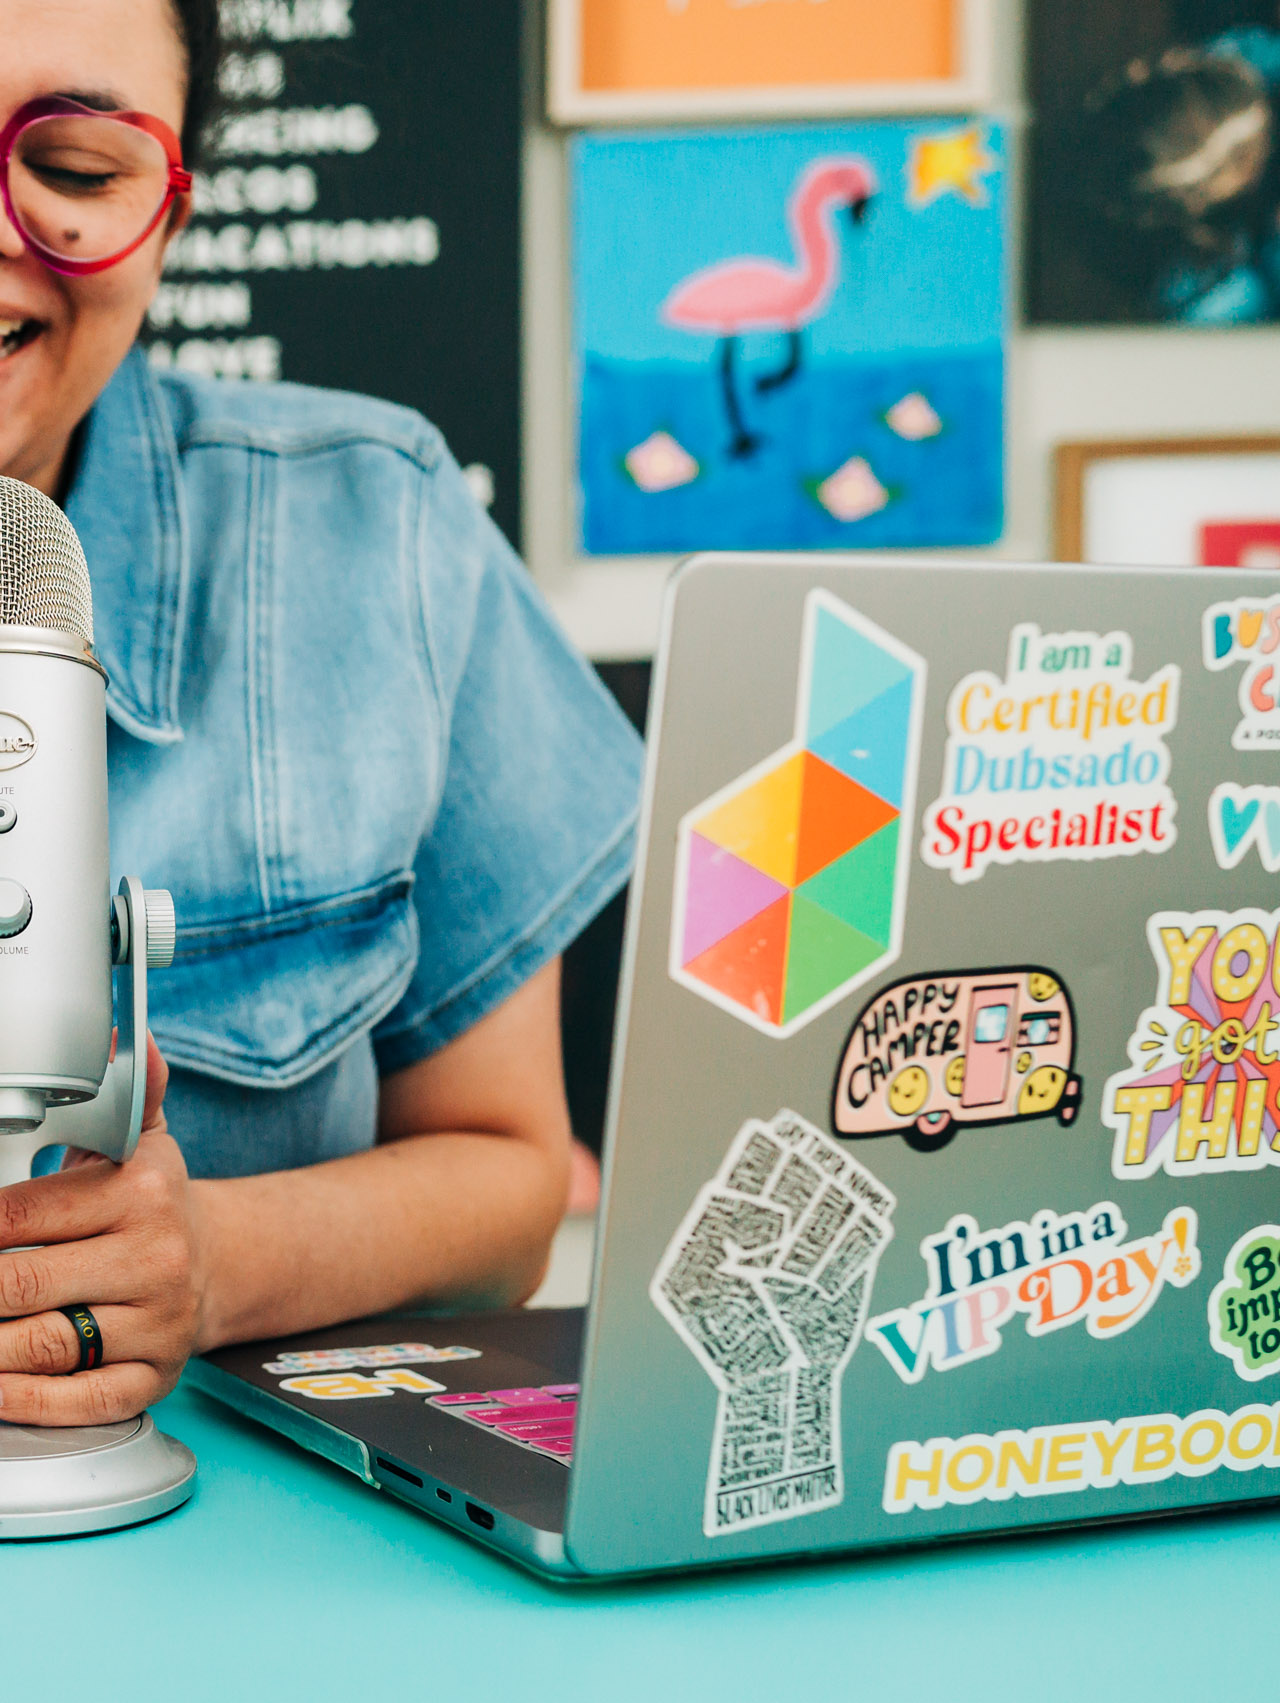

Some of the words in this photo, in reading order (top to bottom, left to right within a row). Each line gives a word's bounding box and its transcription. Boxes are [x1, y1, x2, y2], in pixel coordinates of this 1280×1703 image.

[1017, 635, 1029, 672] I
[1039, 641, 1091, 674] am
[1105, 641, 1122, 668] a
[958, 677, 1171, 741] Certified
[952, 739, 1161, 797] Dubsado
[932, 800, 1168, 871] Specialist
[1159, 922, 1280, 1006] YO
[858, 983, 961, 1057] HAPPY
[1175, 1001, 1280, 1081] got
[847, 1019, 961, 1109] CAMPER
[1113, 1078, 1280, 1166] THI
[1041, 1219, 1084, 1259] in
[1091, 1211, 1117, 1243] a
[876, 1286, 1011, 1374] VIP
[1018, 1216, 1194, 1330] Day!
[893, 1411, 1280, 1502] HONEYBOO
